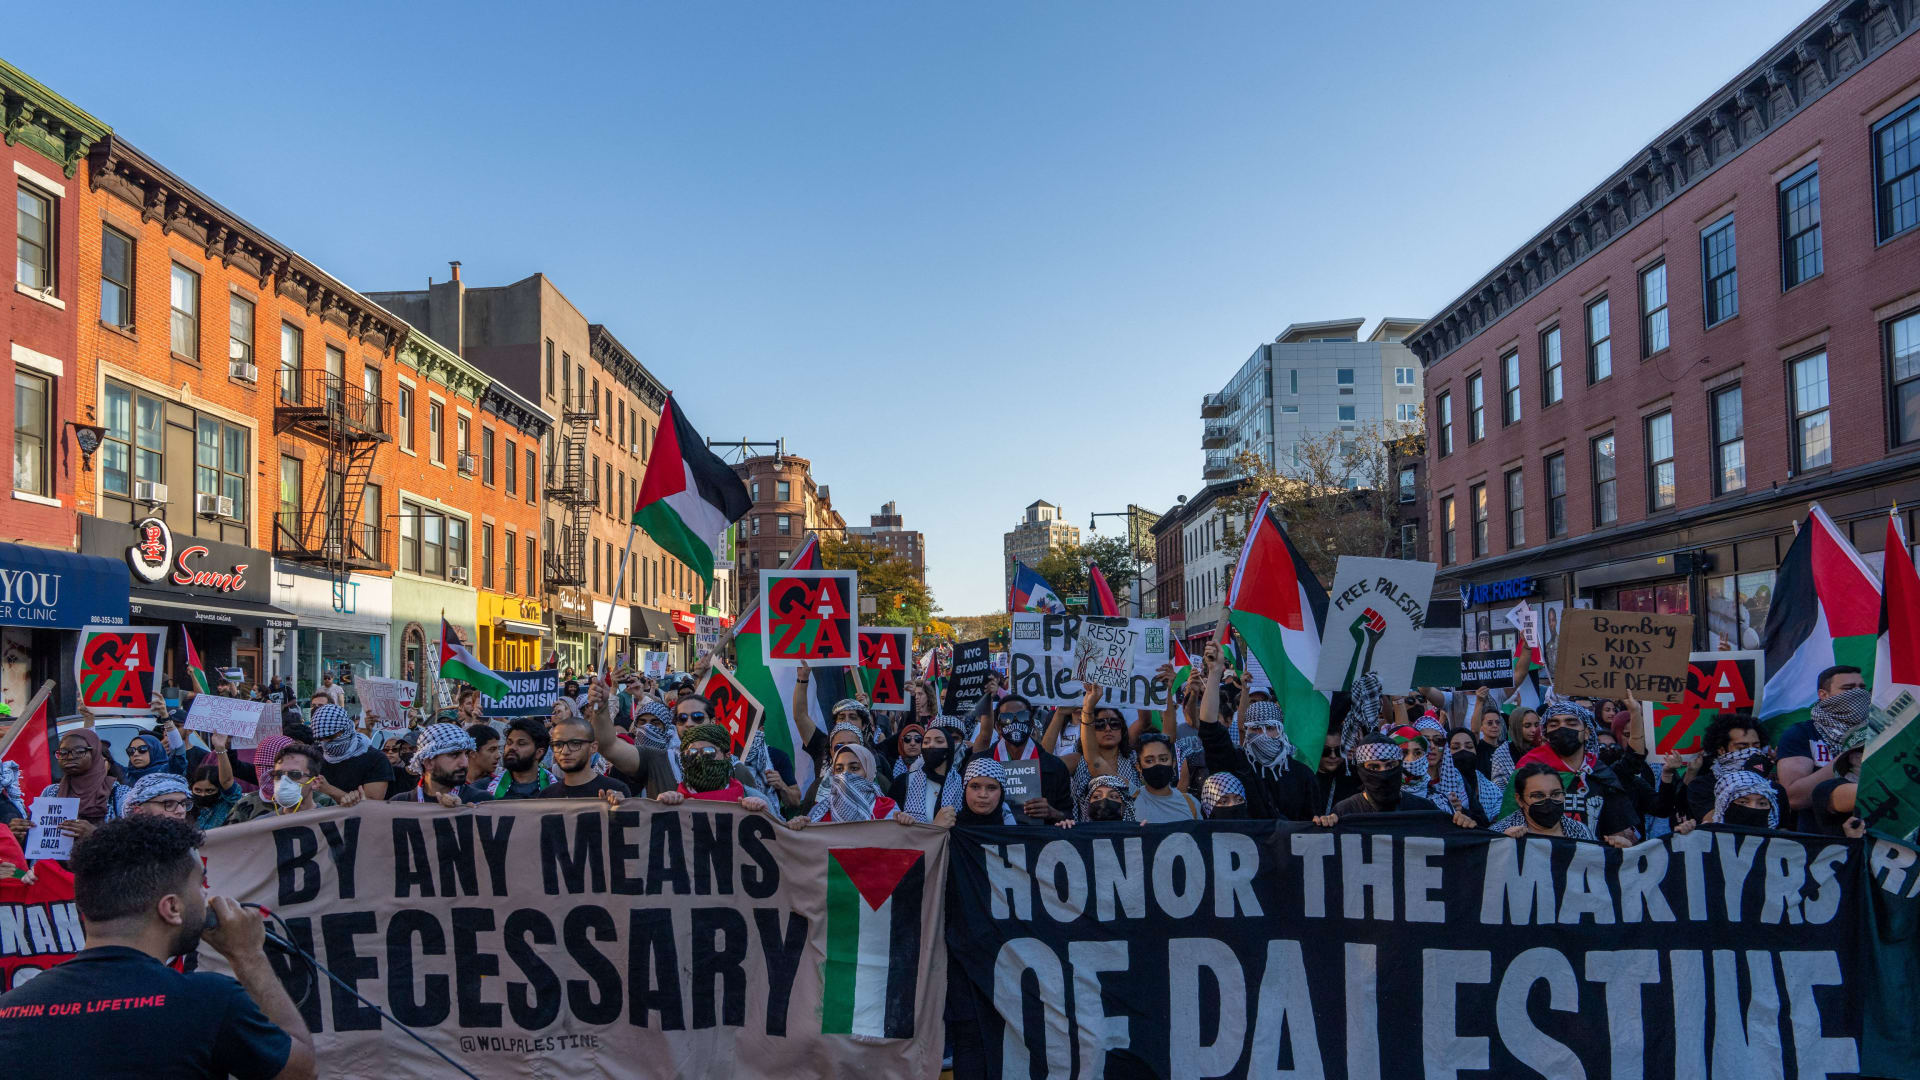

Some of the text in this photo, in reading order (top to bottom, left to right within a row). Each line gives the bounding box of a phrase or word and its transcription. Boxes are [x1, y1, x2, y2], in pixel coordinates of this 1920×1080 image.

[174, 546, 248, 592] Sumi
[0, 568, 61, 606] YOU
[1474, 576, 1527, 603] AIR FORCE
[1335, 577, 1424, 631] FREE PALESTINE
[18, 607, 57, 620] CLINIC
[699, 616, 714, 625] FROM
[700, 626, 711, 634] THE
[1088, 624, 1139, 646] RESIST
[696, 634, 717, 642] RIVER
[1109, 644, 1126, 658] BY
[1605, 637, 1652, 654] KIDS
[964, 647, 981, 659] NYC
[955, 660, 988, 674] STANDS
[1104, 656, 1126, 669] ANY
[1469, 660, 1495, 670] DOLLARS
[1496, 659, 1510, 668] FEED
[1610, 655, 1645, 669] NOT
[960, 675, 983, 685] WITH
[1095, 666, 1127, 680] MEANS
[1479, 671, 1491, 680] WAR
[1493, 670, 1513, 679] CRIMES
[509, 677, 556, 693] NISM IS
[1087, 673, 1128, 688] NECESSARY
[955, 688, 982, 698] GAZA
[481, 692, 557, 709] TERRORISM
[1002, 722, 1028, 735] BROOKLYN
[48, 805, 62, 814] NYC
[43, 828, 61, 837] WITH
[40, 839, 60, 848] GAZA
[272, 811, 780, 906] BY ANY MEANS
[981, 830, 1849, 924] HONOR THE MARTYRS
[264, 905, 808, 1037] NECESSARY
[0, 994, 166, 1019] WITHIN OUR LIFETIME
[993, 937, 1131, 1080] OF
[460, 1034, 599, 1053] @WOLPALESTINE
